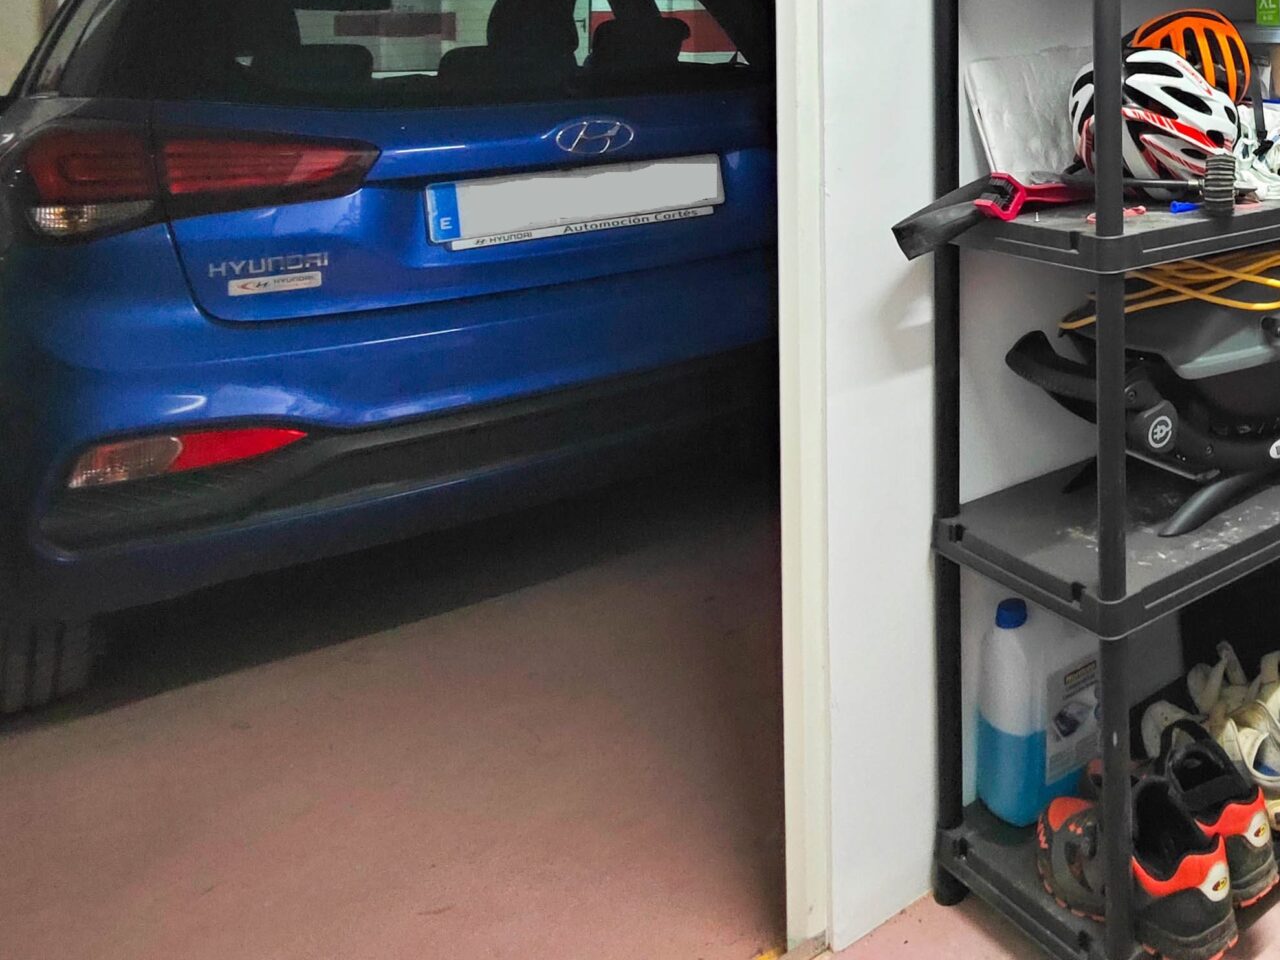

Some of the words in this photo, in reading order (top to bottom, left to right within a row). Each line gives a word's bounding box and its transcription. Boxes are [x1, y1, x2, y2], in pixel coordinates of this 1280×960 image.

[440, 217, 453, 230] E
[489, 232, 533, 243] HYUNDAI
[562, 215, 650, 235] Automoción
[654, 208, 699, 223] Cortés
[208, 252, 329, 278] HYUNDAI
